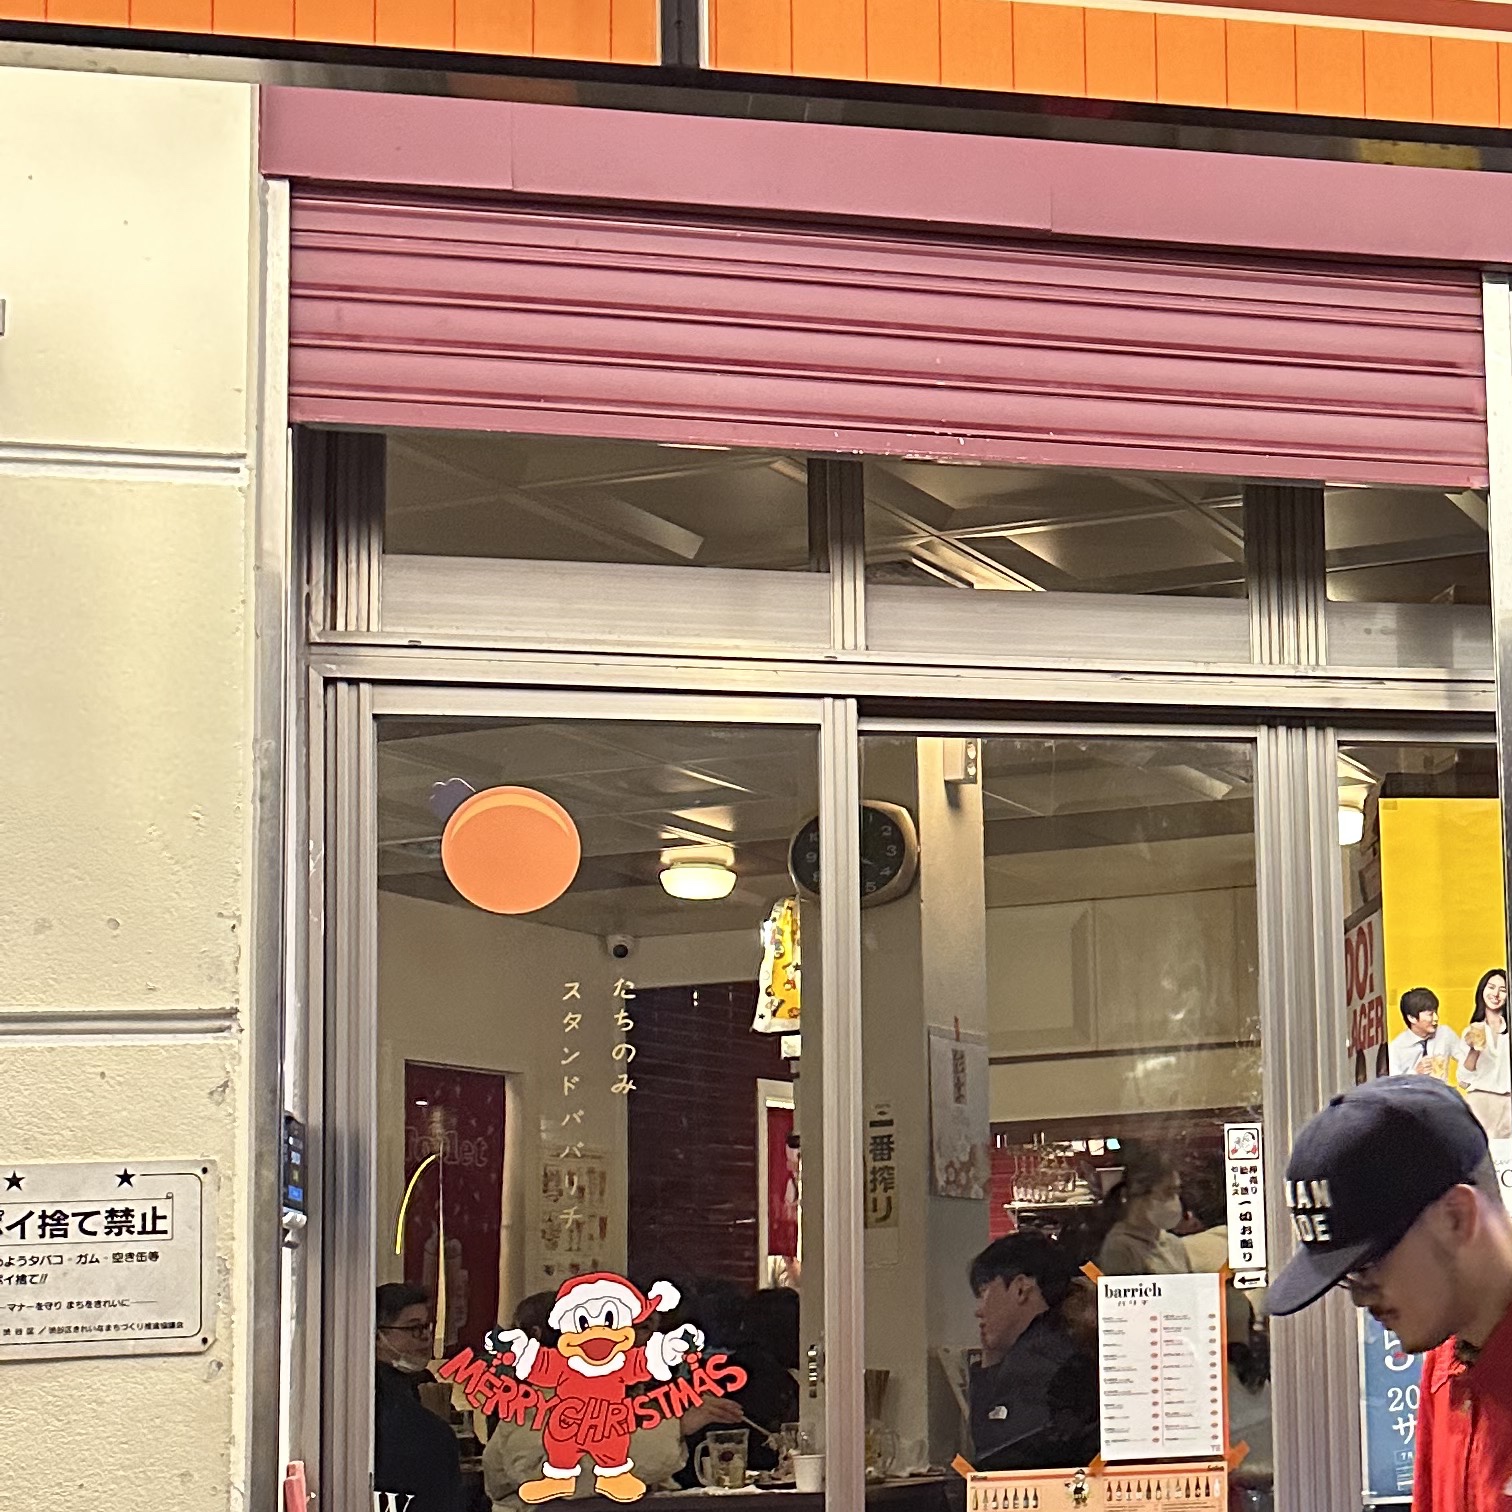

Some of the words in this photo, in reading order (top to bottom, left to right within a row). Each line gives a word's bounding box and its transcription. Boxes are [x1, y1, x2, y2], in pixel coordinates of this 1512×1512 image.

[610, 977, 637, 1094] たちのみ
[1348, 996, 1384, 1059] AGER
[1104, 1282, 1162, 1299] barrich
[438, 1347, 561, 1431] MERRY
[548, 1353, 749, 1445] CHRISTMAS
